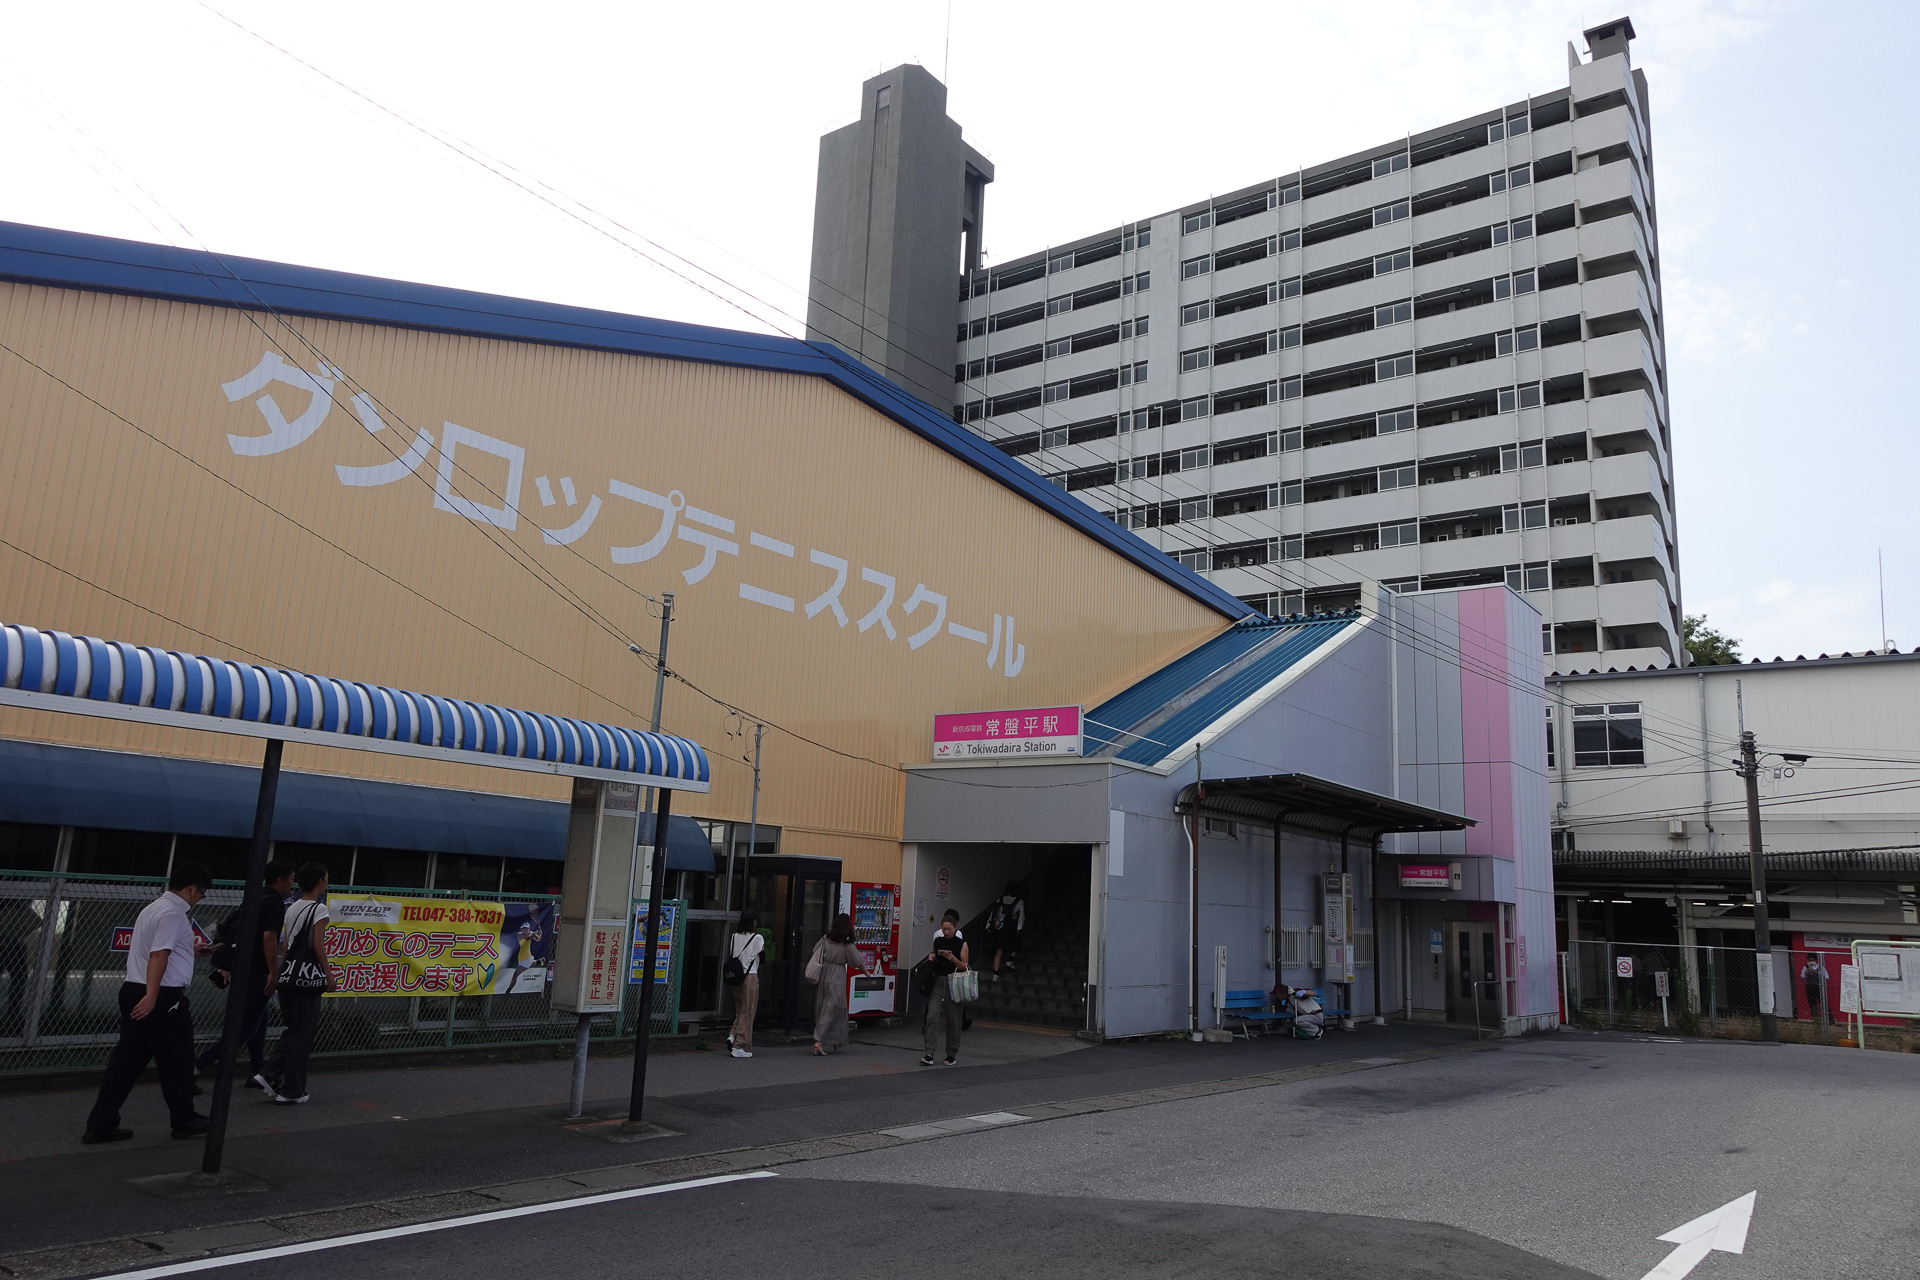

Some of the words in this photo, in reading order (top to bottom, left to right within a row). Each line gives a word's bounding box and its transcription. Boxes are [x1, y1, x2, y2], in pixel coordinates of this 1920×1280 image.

[221, 350, 1026, 678] ダンロップテニススクール
[986, 715, 1059, 737] 常盤平駅
[967, 743, 1021, 755] Tokiwadaira
[1024, 741, 1056, 752] Station
[339, 905, 392, 914] DUNLOP
[403, 906, 502, 925] TEL047-384-7331
[324, 927, 498, 959] 初めてのテニス
[589, 931, 607, 1000] 駐停車禁止
[606, 931, 620, 1000] バス停留所に付き
